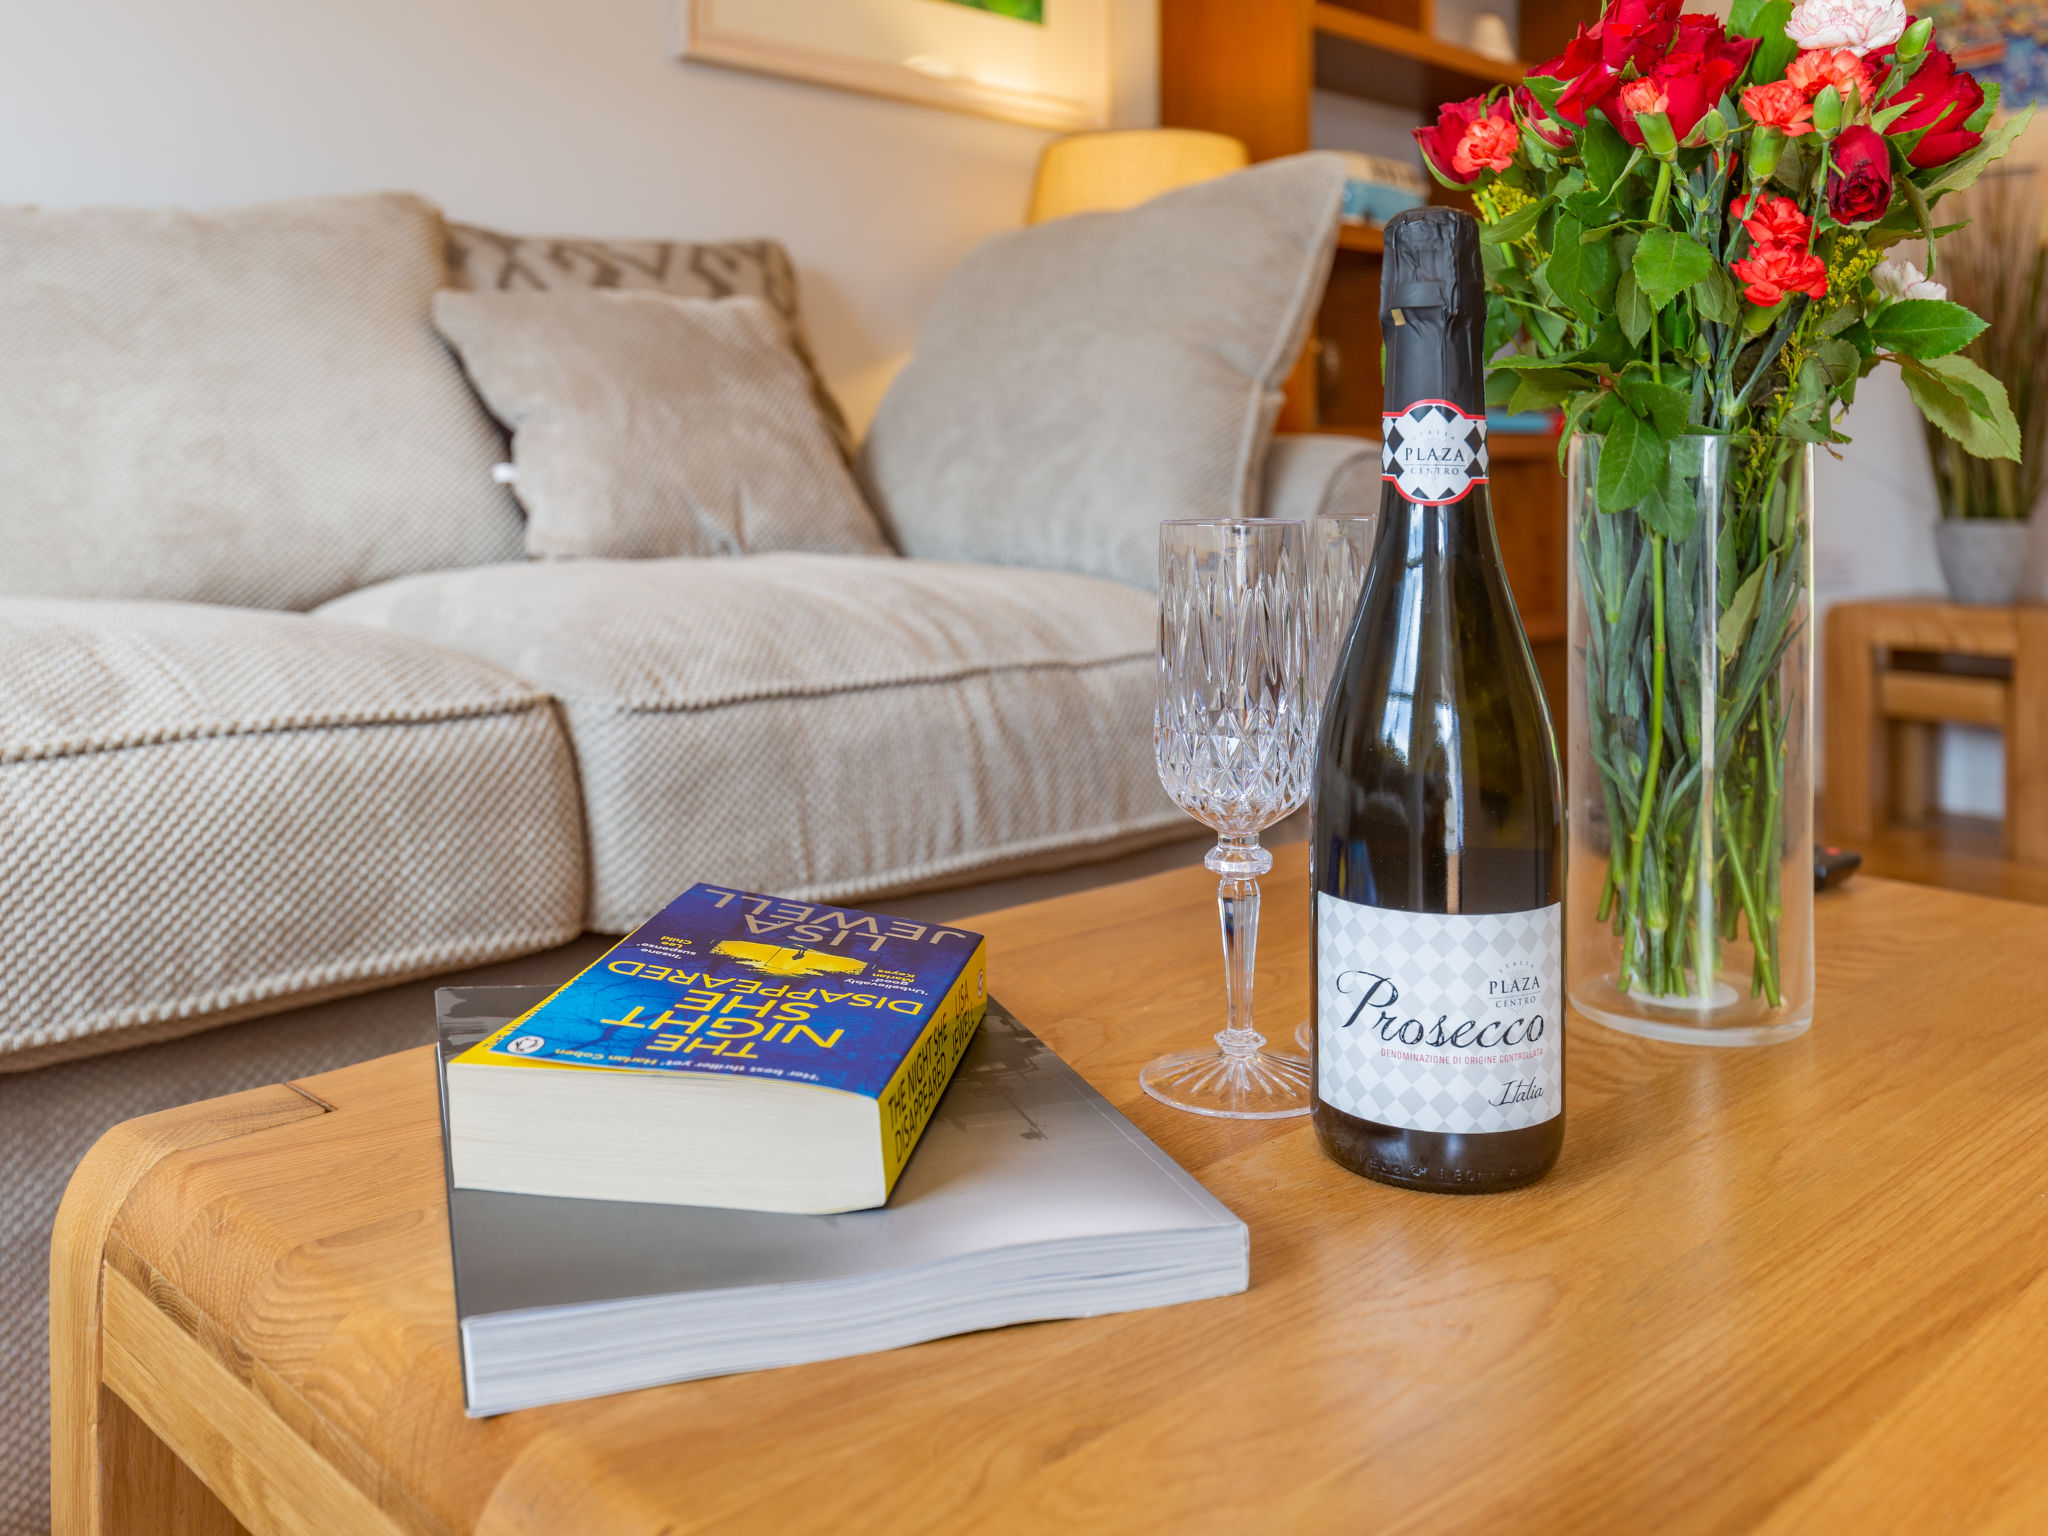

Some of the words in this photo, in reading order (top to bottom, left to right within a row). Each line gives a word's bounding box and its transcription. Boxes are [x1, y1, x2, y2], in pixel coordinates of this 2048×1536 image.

[1405, 447, 1464, 461] PLAZA
[1410, 467, 1460, 475] CENTRO
[704, 888, 966, 945] JEWELL
[660, 935, 692, 945] Child
[744, 914, 887, 952] LISA
[661, 941, 683, 949] Lee
[872, 973, 915, 983] Marian
[877, 969, 915, 978] Keyes
[607, 960, 924, 1016] DISAPPEARED
[1489, 976, 1541, 995] PLAZA
[674, 988, 820, 1022] SHE
[954, 978, 969, 1020] LISA
[1495, 995, 1537, 1009] CENTRO
[1336, 970, 1544, 1048] Prosecco
[600, 1005, 845, 1049] NIGHT
[951, 1003, 975, 1062] JEWELL
[554, 1048, 604, 1060] Coben
[646, 1032, 759, 1059] THE
[608, 1054, 657, 1065] Harlan
[1380, 1048, 1450, 1065] DENOMINAZIONE
[1453, 1055, 1462, 1065] DI
[1464, 1055, 1497, 1065] ORIGINE
[1499, 1047, 1544, 1064] CONTROLLATA
[697, 1062, 745, 1074] thriller
[751, 1066, 783, 1076] best
[888, 1078, 907, 1129] THE
[907, 1033, 932, 1099] NIGHT
[933, 1012, 948, 1056] SHE
[1488, 1076, 1544, 1106] Italia
[894, 1052, 947, 1163] DISAPPEARED
